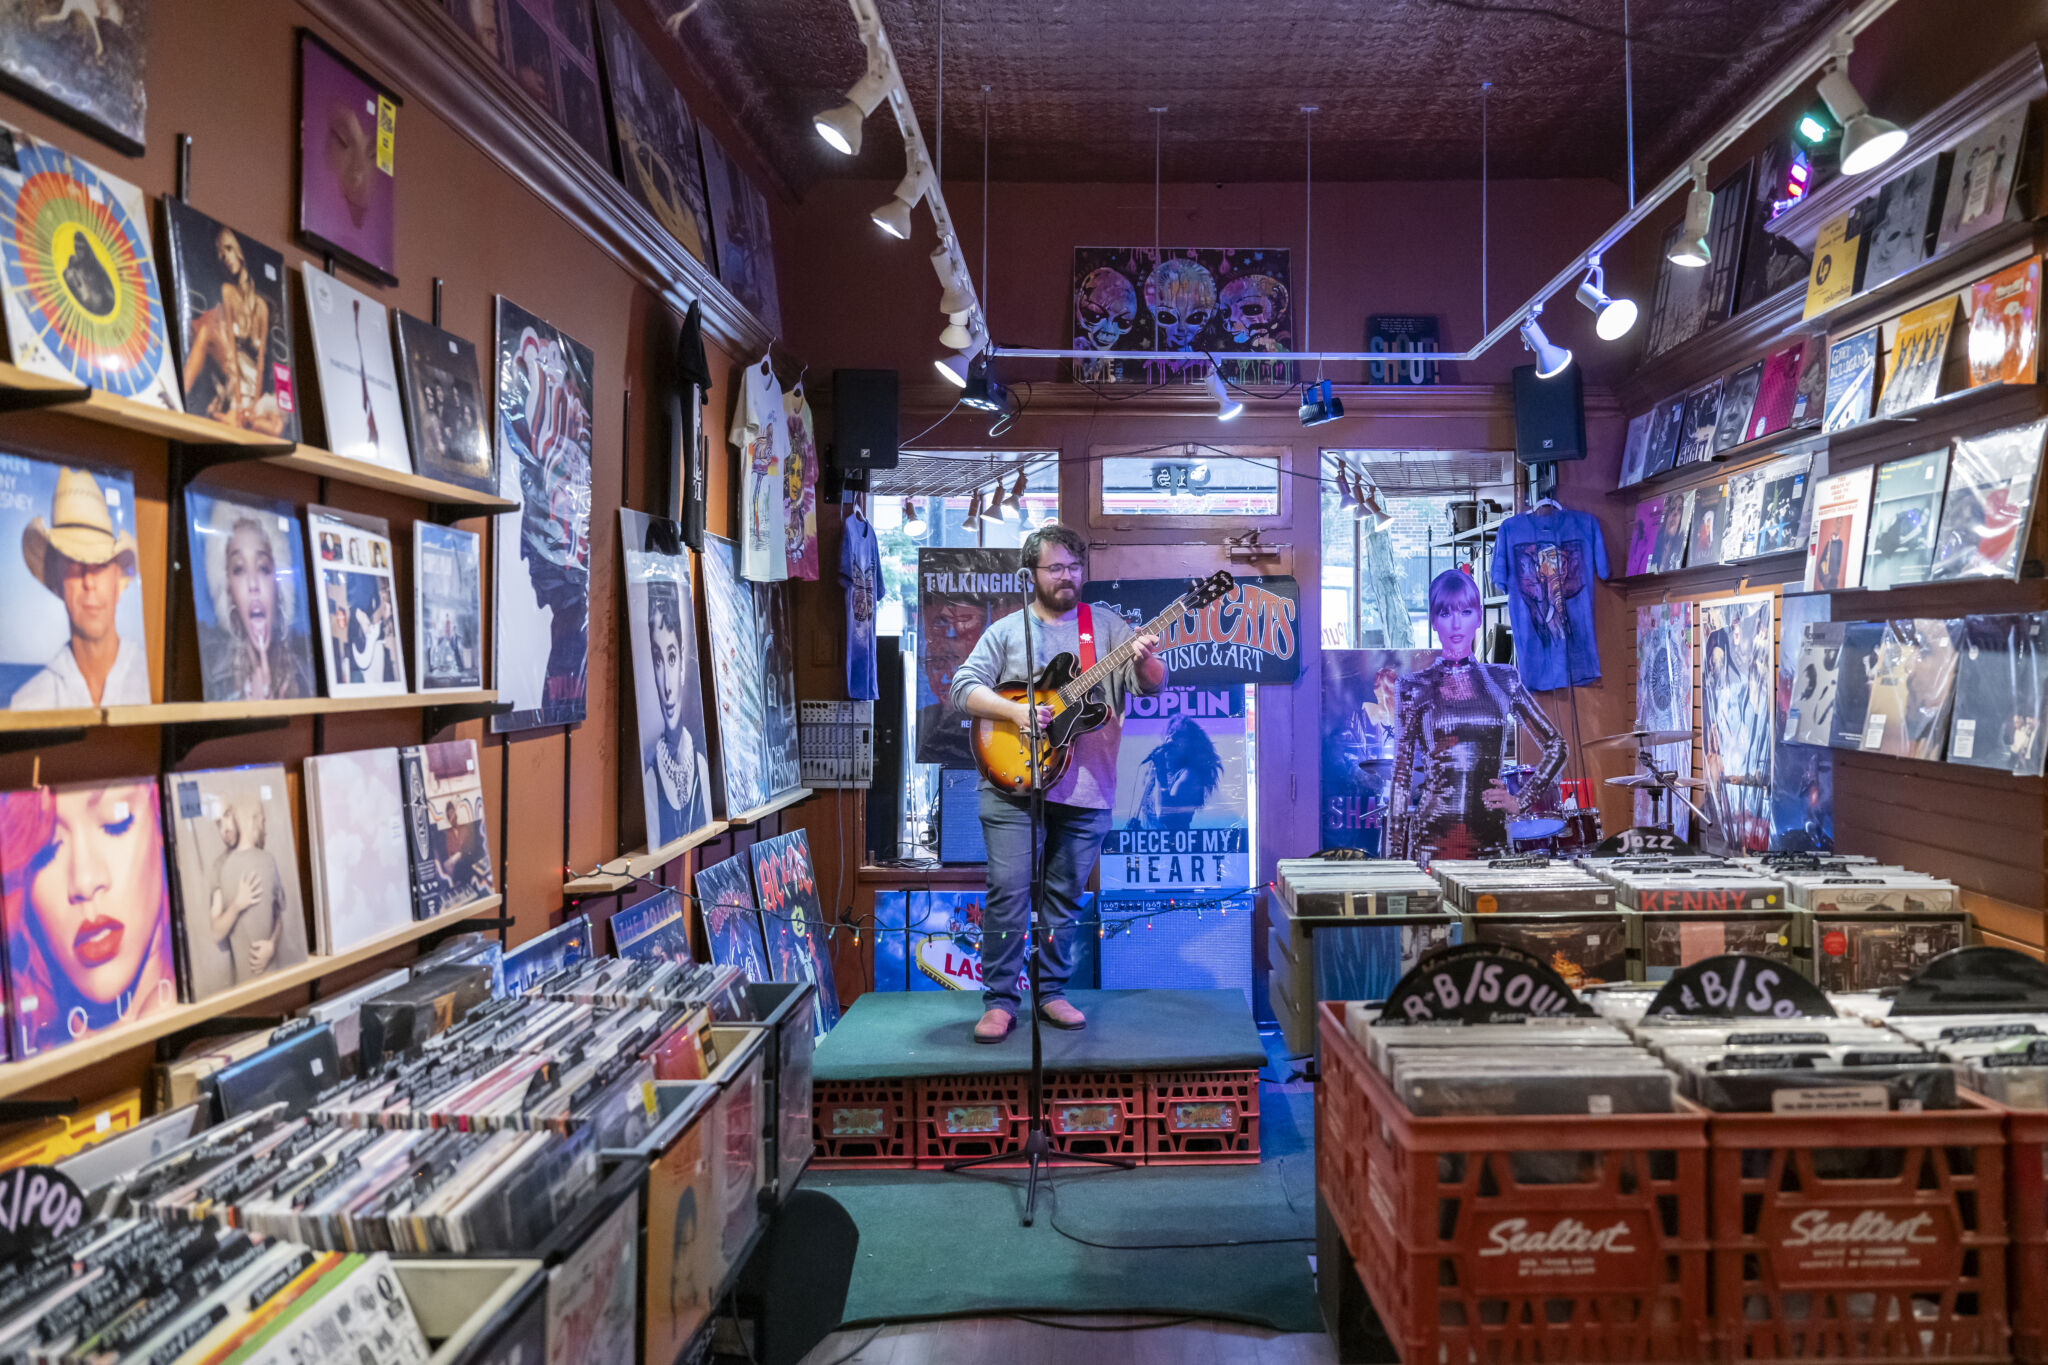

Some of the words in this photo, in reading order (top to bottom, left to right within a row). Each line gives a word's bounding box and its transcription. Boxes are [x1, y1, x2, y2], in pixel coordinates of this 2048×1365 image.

[1371, 334, 1440, 385] SHOUT!
[1210, 641, 1223, 666] &
[1224, 645, 1264, 673] ART
[1125, 691, 1230, 718] JOPLIN
[1119, 831, 1171, 853] PIECE
[1175, 831, 1198, 853] OF
[1202, 830, 1231, 853] MY
[1126, 855, 1226, 884] HEART
[22, 978, 173, 1056] LOUD
[1479, 1218, 1635, 1256] Sealtest
[1782, 1209, 1937, 1247] Sealtest
